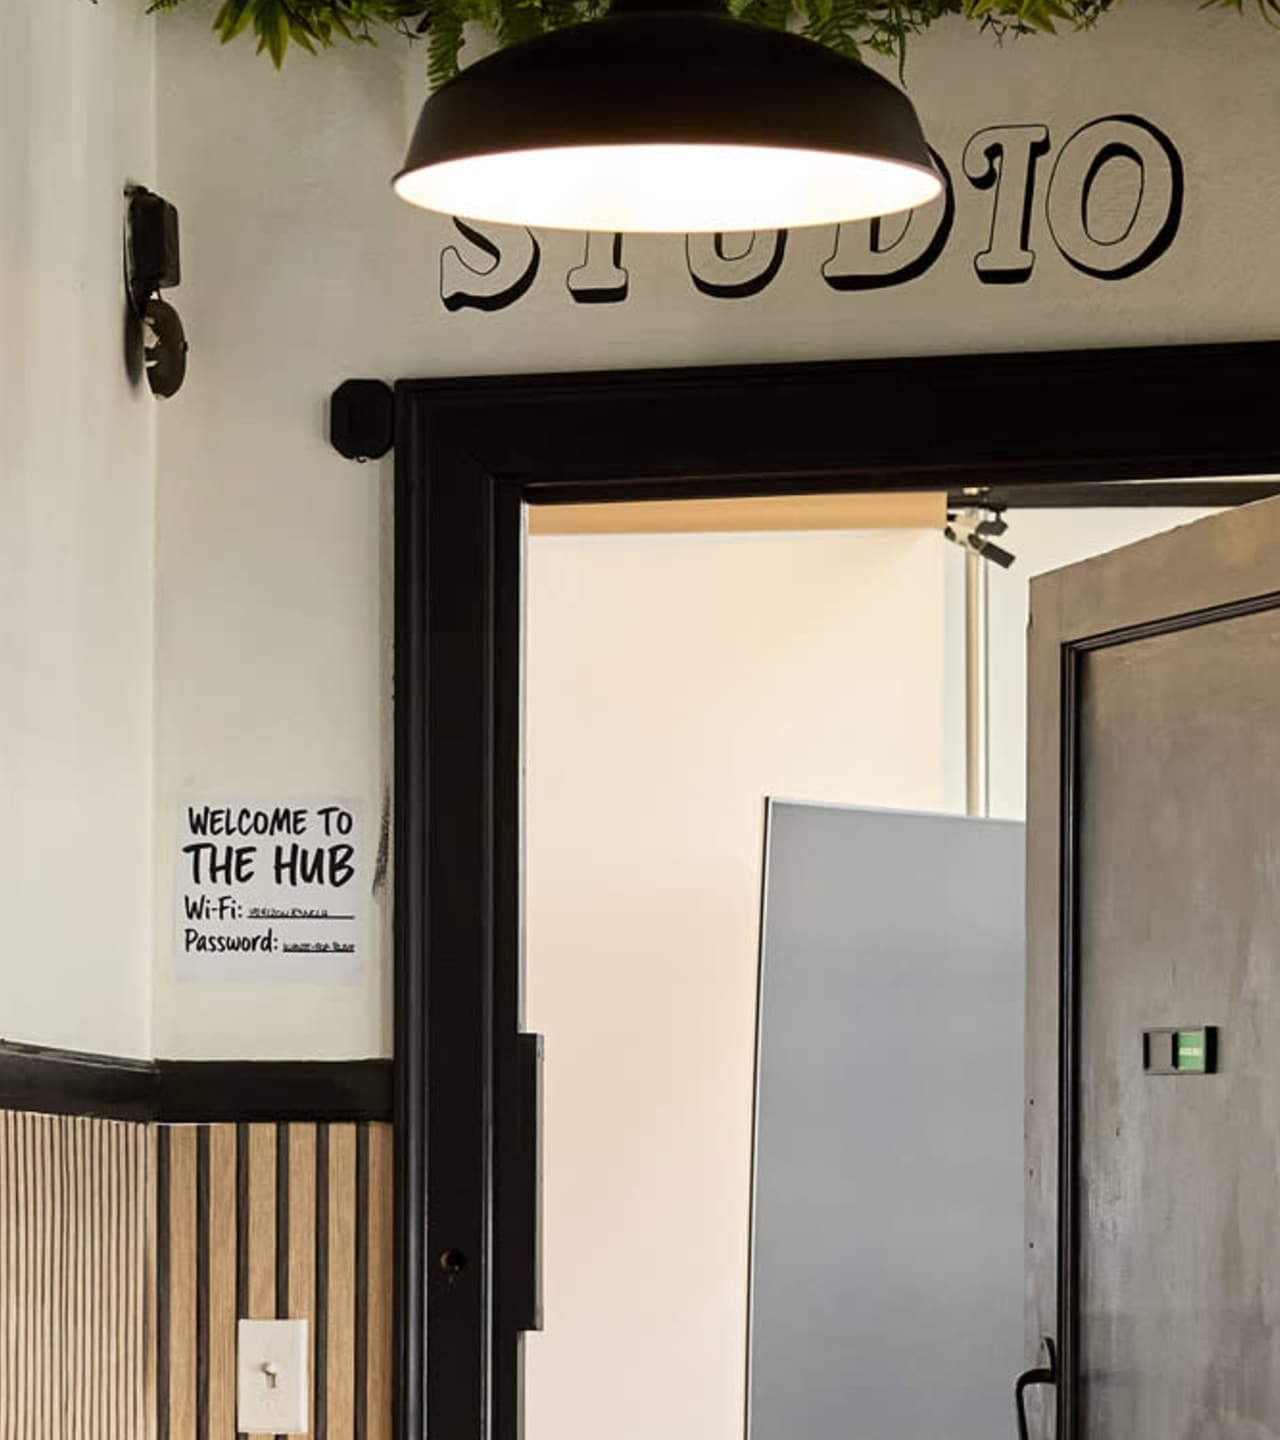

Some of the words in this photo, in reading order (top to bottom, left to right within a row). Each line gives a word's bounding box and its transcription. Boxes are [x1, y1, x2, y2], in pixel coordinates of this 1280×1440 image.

[188, 806, 308, 837] WELCOME
[317, 806, 353, 837] TO
[182, 842, 257, 886] THE
[273, 842, 355, 887] HUB
[184, 894, 243, 920] Wi-Fi:
[184, 927, 279, 954] Password:
